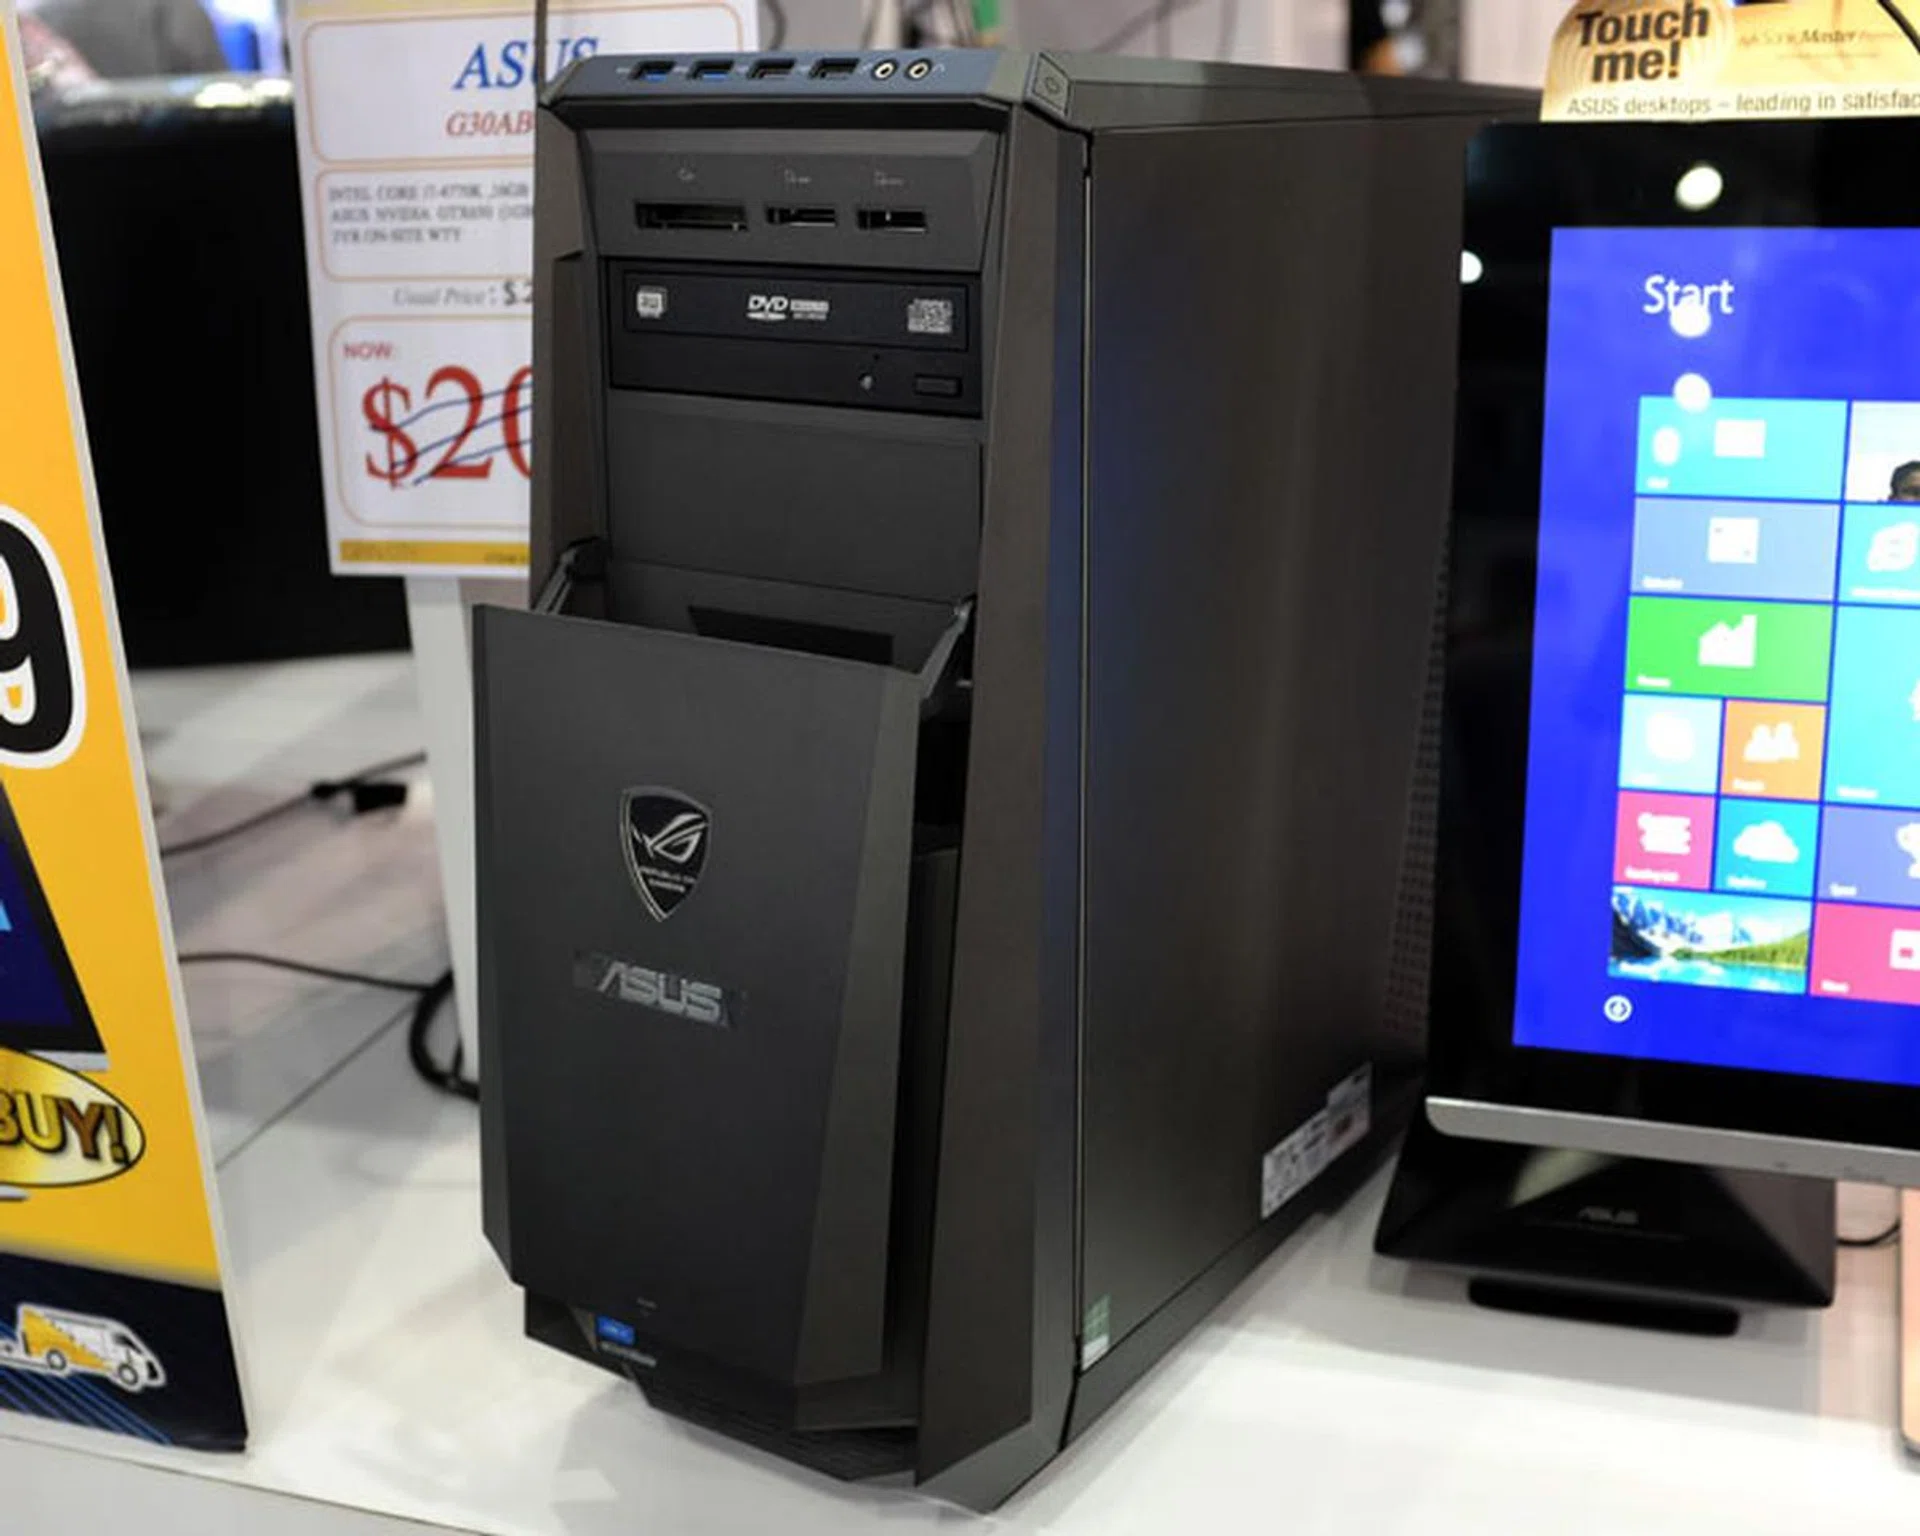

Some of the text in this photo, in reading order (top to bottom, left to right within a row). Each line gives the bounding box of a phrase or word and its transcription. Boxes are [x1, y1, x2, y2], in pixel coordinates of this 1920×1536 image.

[1577, 1, 1710, 47] Touch
[1591, 43, 1681, 83] me!
[1567, 98, 1619, 116] ASUS
[1624, 97, 1713, 117] desktops
[1736, 93, 1812, 115] leading
[1817, 92, 1836, 110] in
[750, 295, 787, 312] DVD
[1643, 274, 1735, 315] Start
[599, 960, 725, 1027] ASUS
[0, 1088, 129, 1166] BUY!
